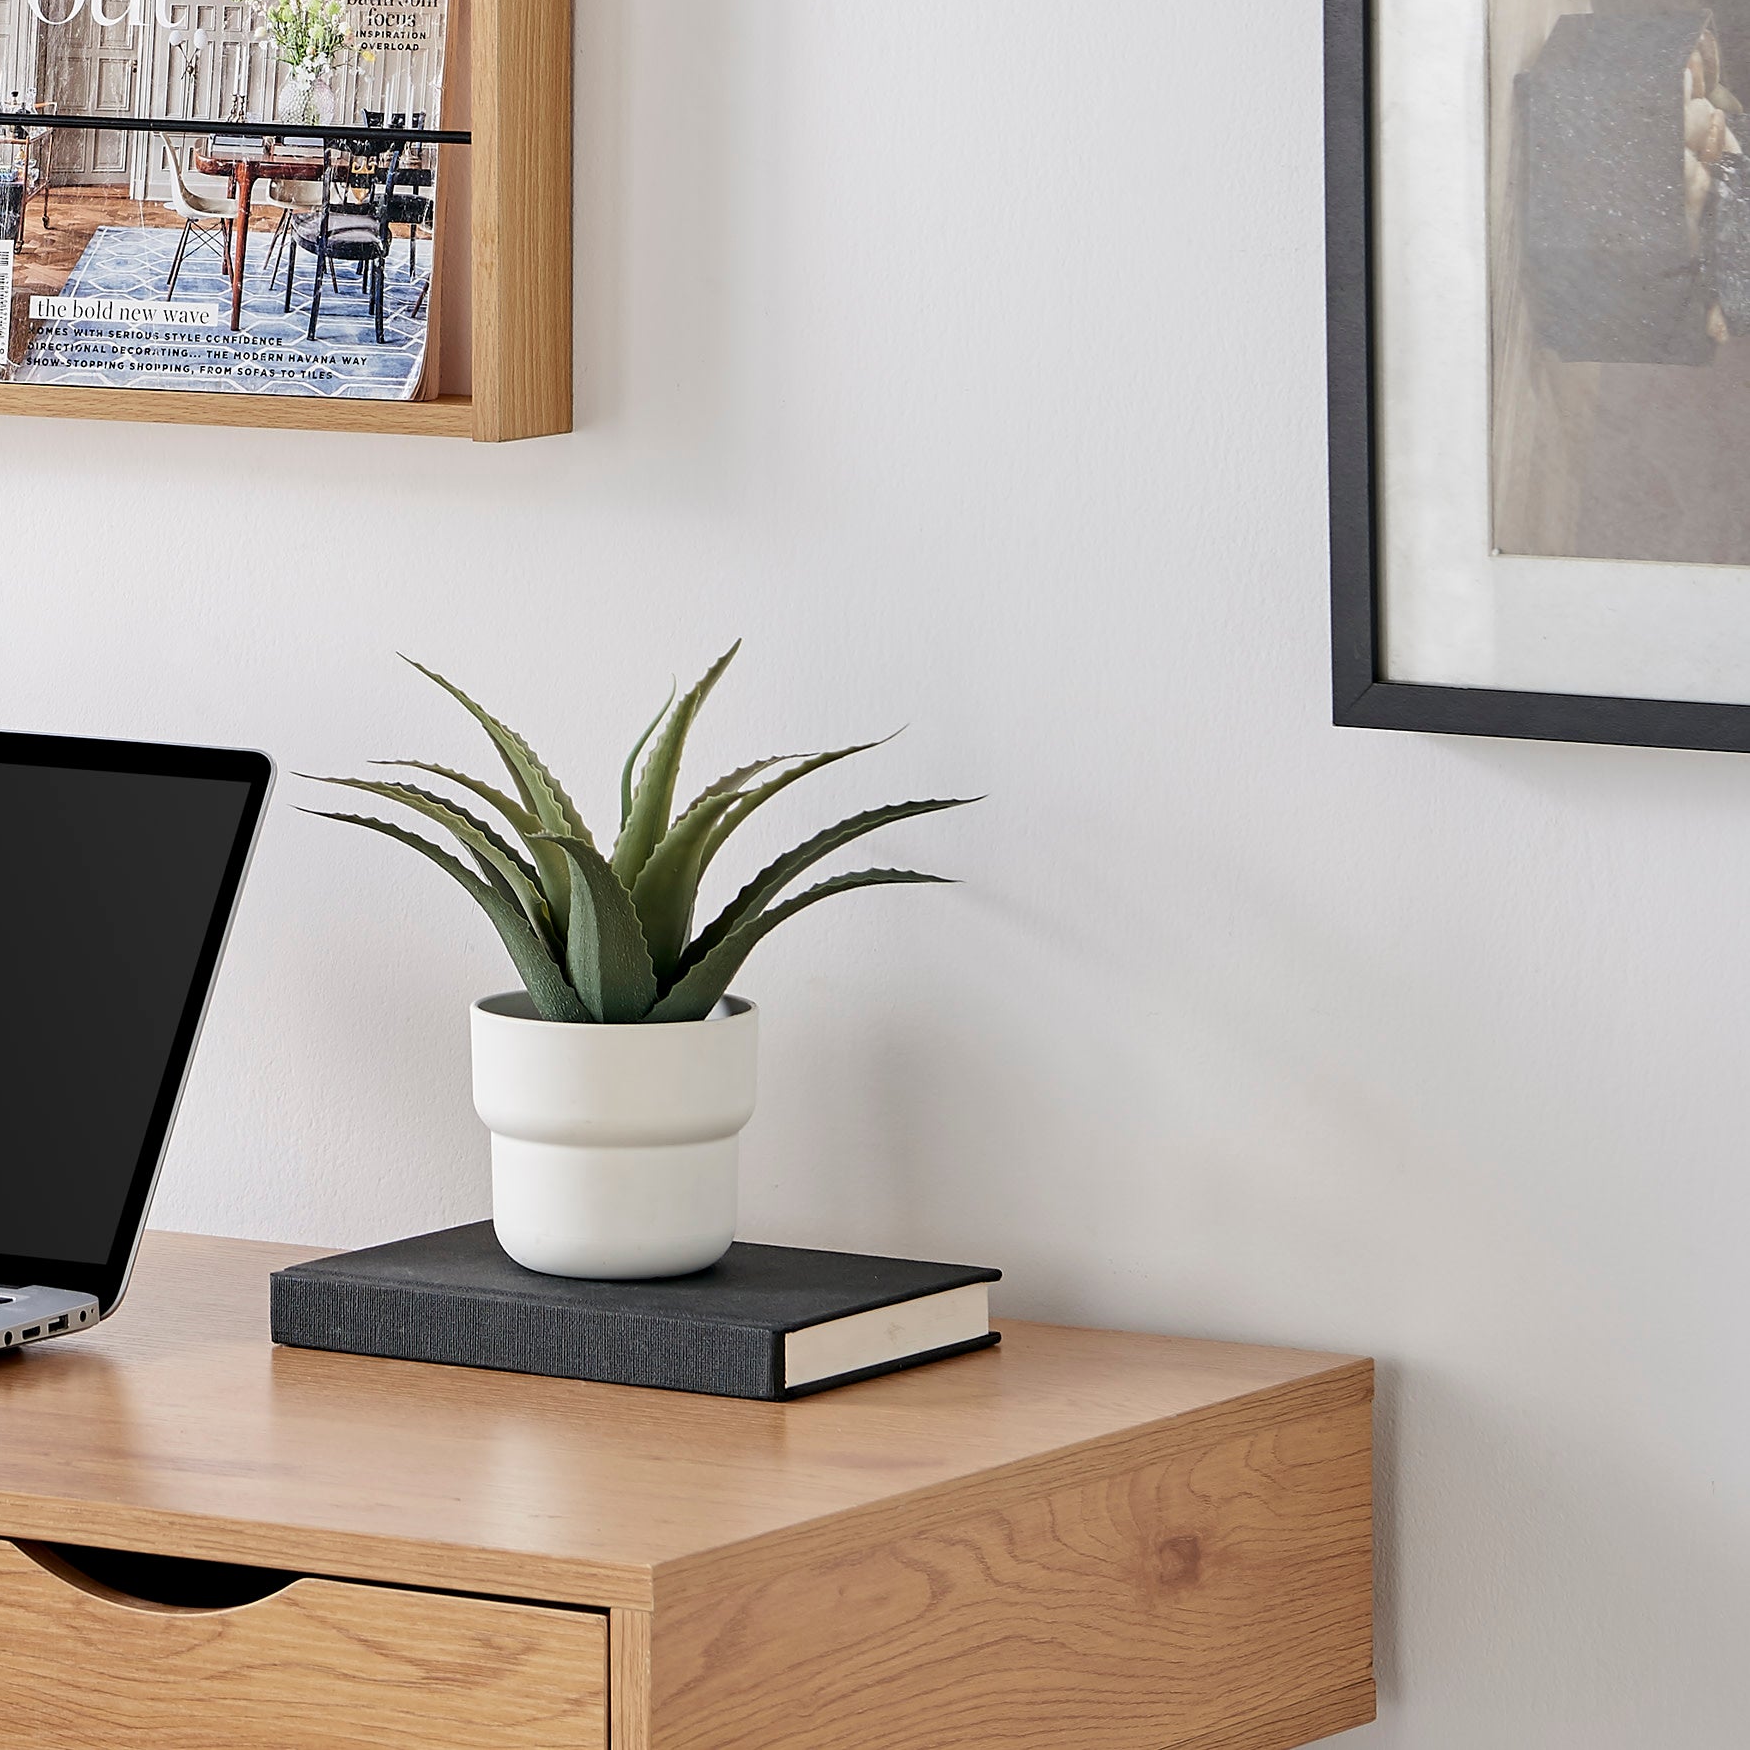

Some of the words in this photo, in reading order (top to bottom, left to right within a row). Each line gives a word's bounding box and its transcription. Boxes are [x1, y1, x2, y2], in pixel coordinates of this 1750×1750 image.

[368, 7, 416, 27] focus
[355, 30, 426, 40] INSPIRATION
[360, 42, 420, 51] OVERLOAD
[38, 298, 67, 318] the
[73, 299, 113, 320] bold
[119, 309, 158, 322] new
[163, 310, 210, 325] wave
[73, 328, 103, 338] WITH
[108, 330, 159, 340] SERIOUS
[164, 332, 201, 343] STYLE
[205, 334, 283, 346] CONFIDENCE
[27, 341, 107, 354] DIRECTIONAL
[111, 345, 201, 359] DECORATING...
[206, 350, 229, 359] THE
[233, 351, 284, 362] MODERN
[288, 354, 336, 365] HAVANA
[342, 356, 368, 366] WAY
[26, 356, 125, 370] SHOW-STOPPING
[129, 363, 194, 375] SHOPPING,
[199, 365, 232, 375] FROM
[237, 367, 275, 378] SOFAS
[281, 369, 295, 379] TO
[300, 370, 333, 380] TILES
